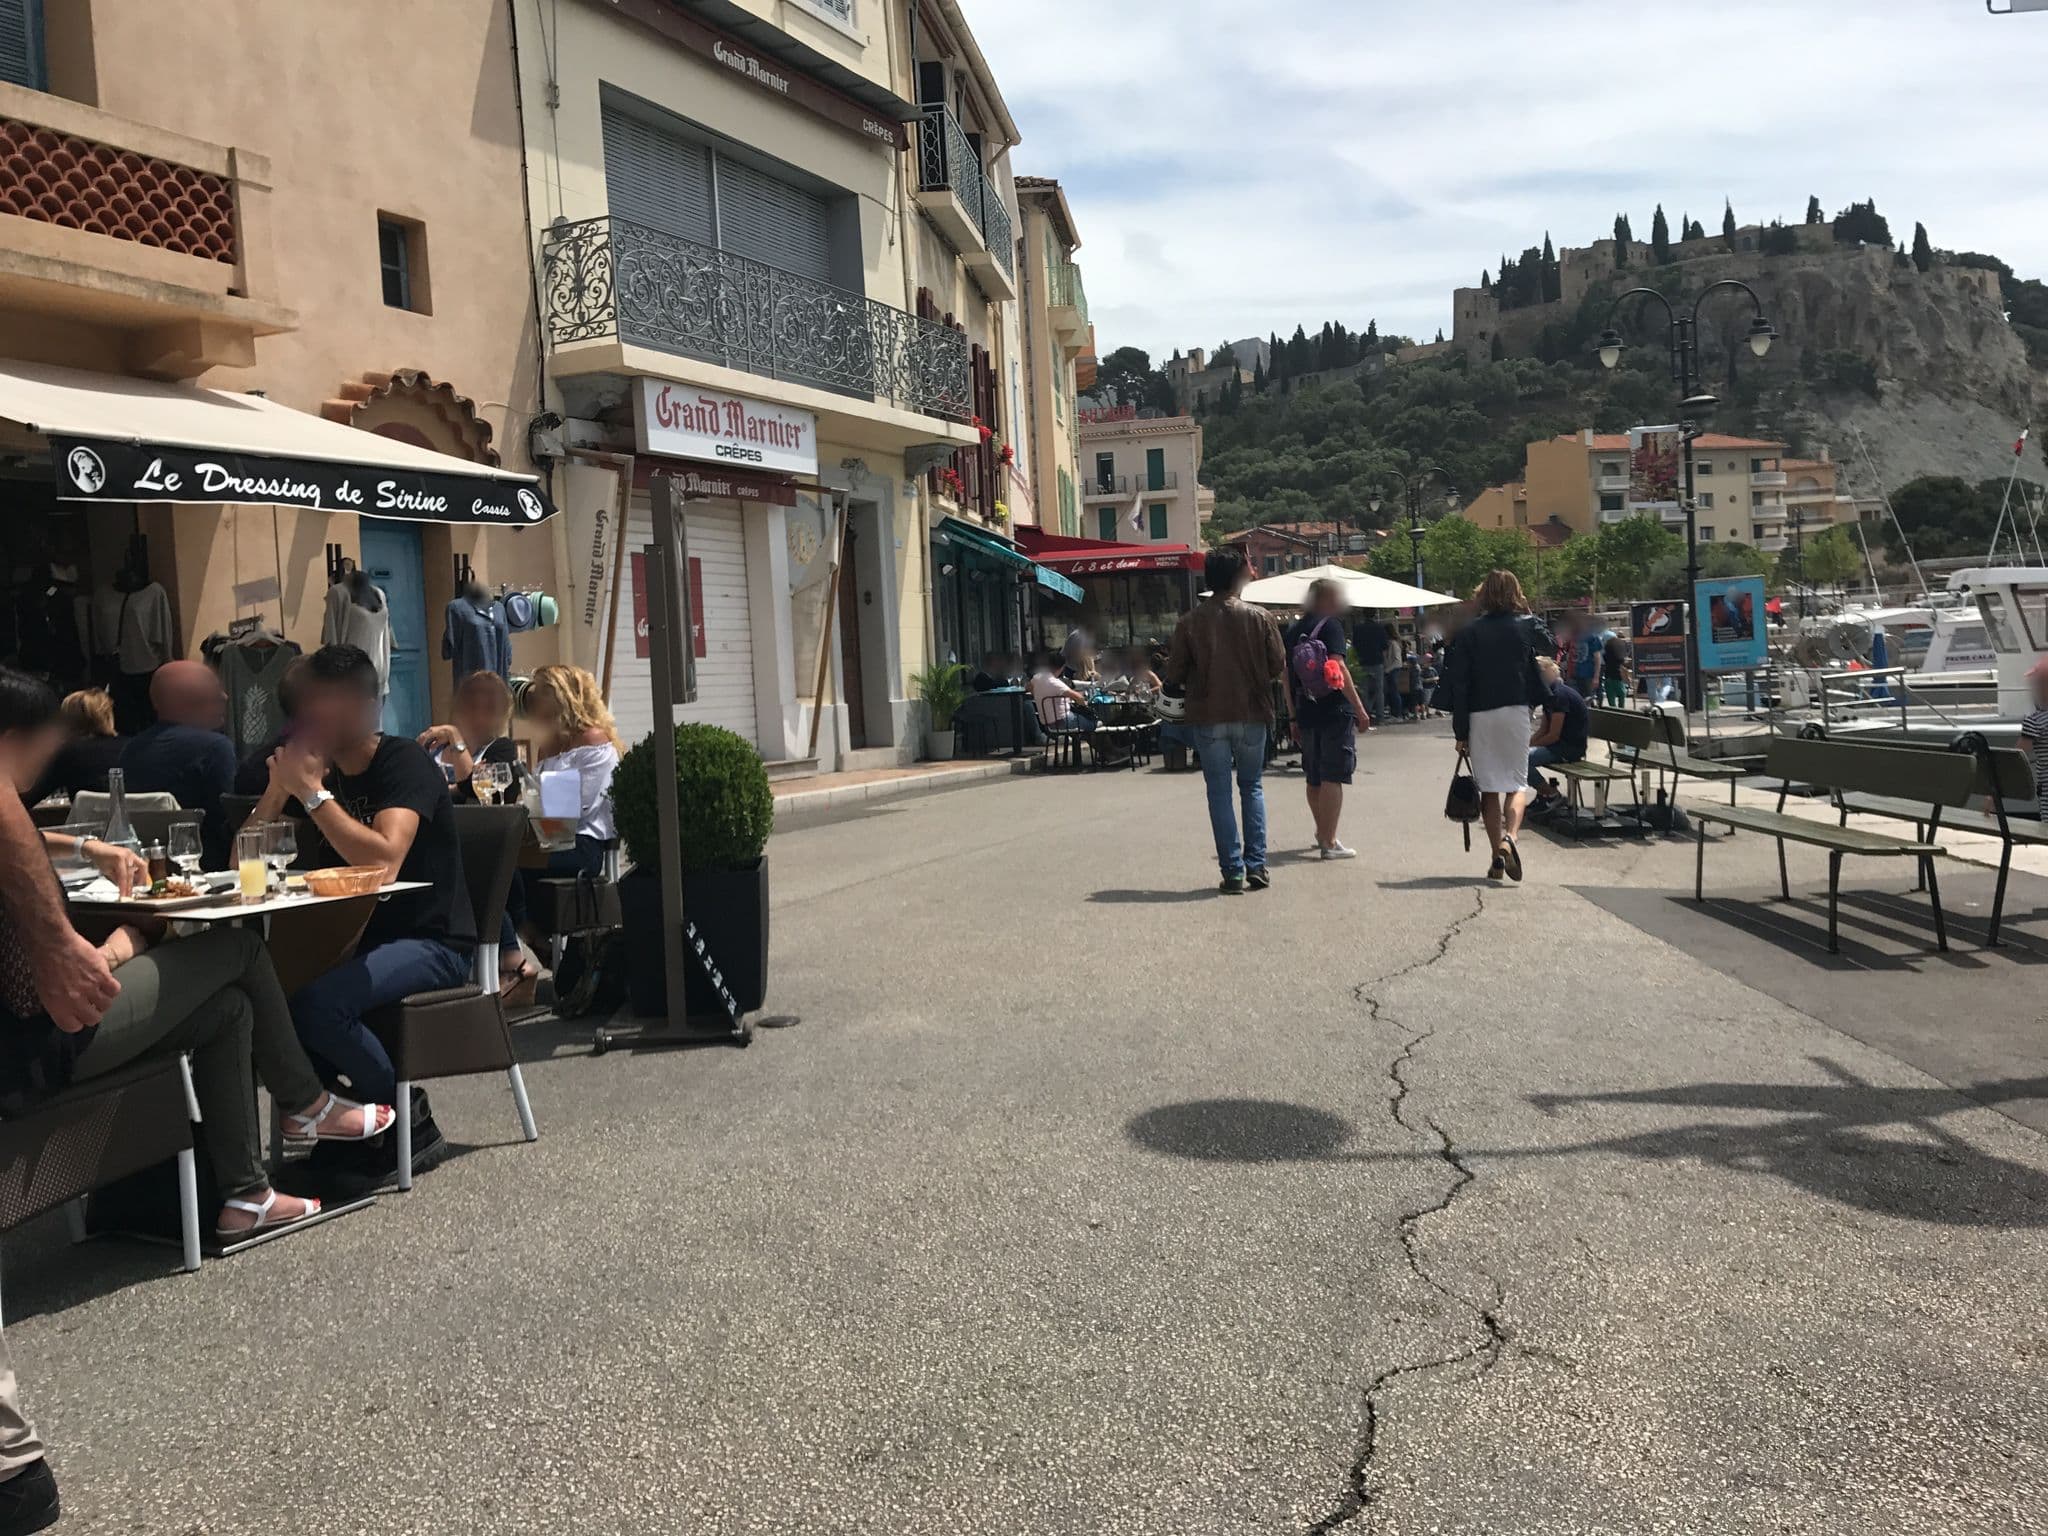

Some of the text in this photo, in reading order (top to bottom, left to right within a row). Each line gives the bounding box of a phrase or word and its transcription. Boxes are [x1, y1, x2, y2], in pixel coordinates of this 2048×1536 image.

[713, 40, 790, 94] Grand Marnier
[655, 385, 802, 450] Grand Marnier
[715, 443, 763, 462] CRÊPES
[133, 457, 511, 517] Le Dressing de Sirine Cassis
[686, 471, 732, 496] Marnier
[584, 509, 609, 627] Grand Marnier
[1100, 561, 1114, 571] et
[1116, 558, 1141, 570] demi
